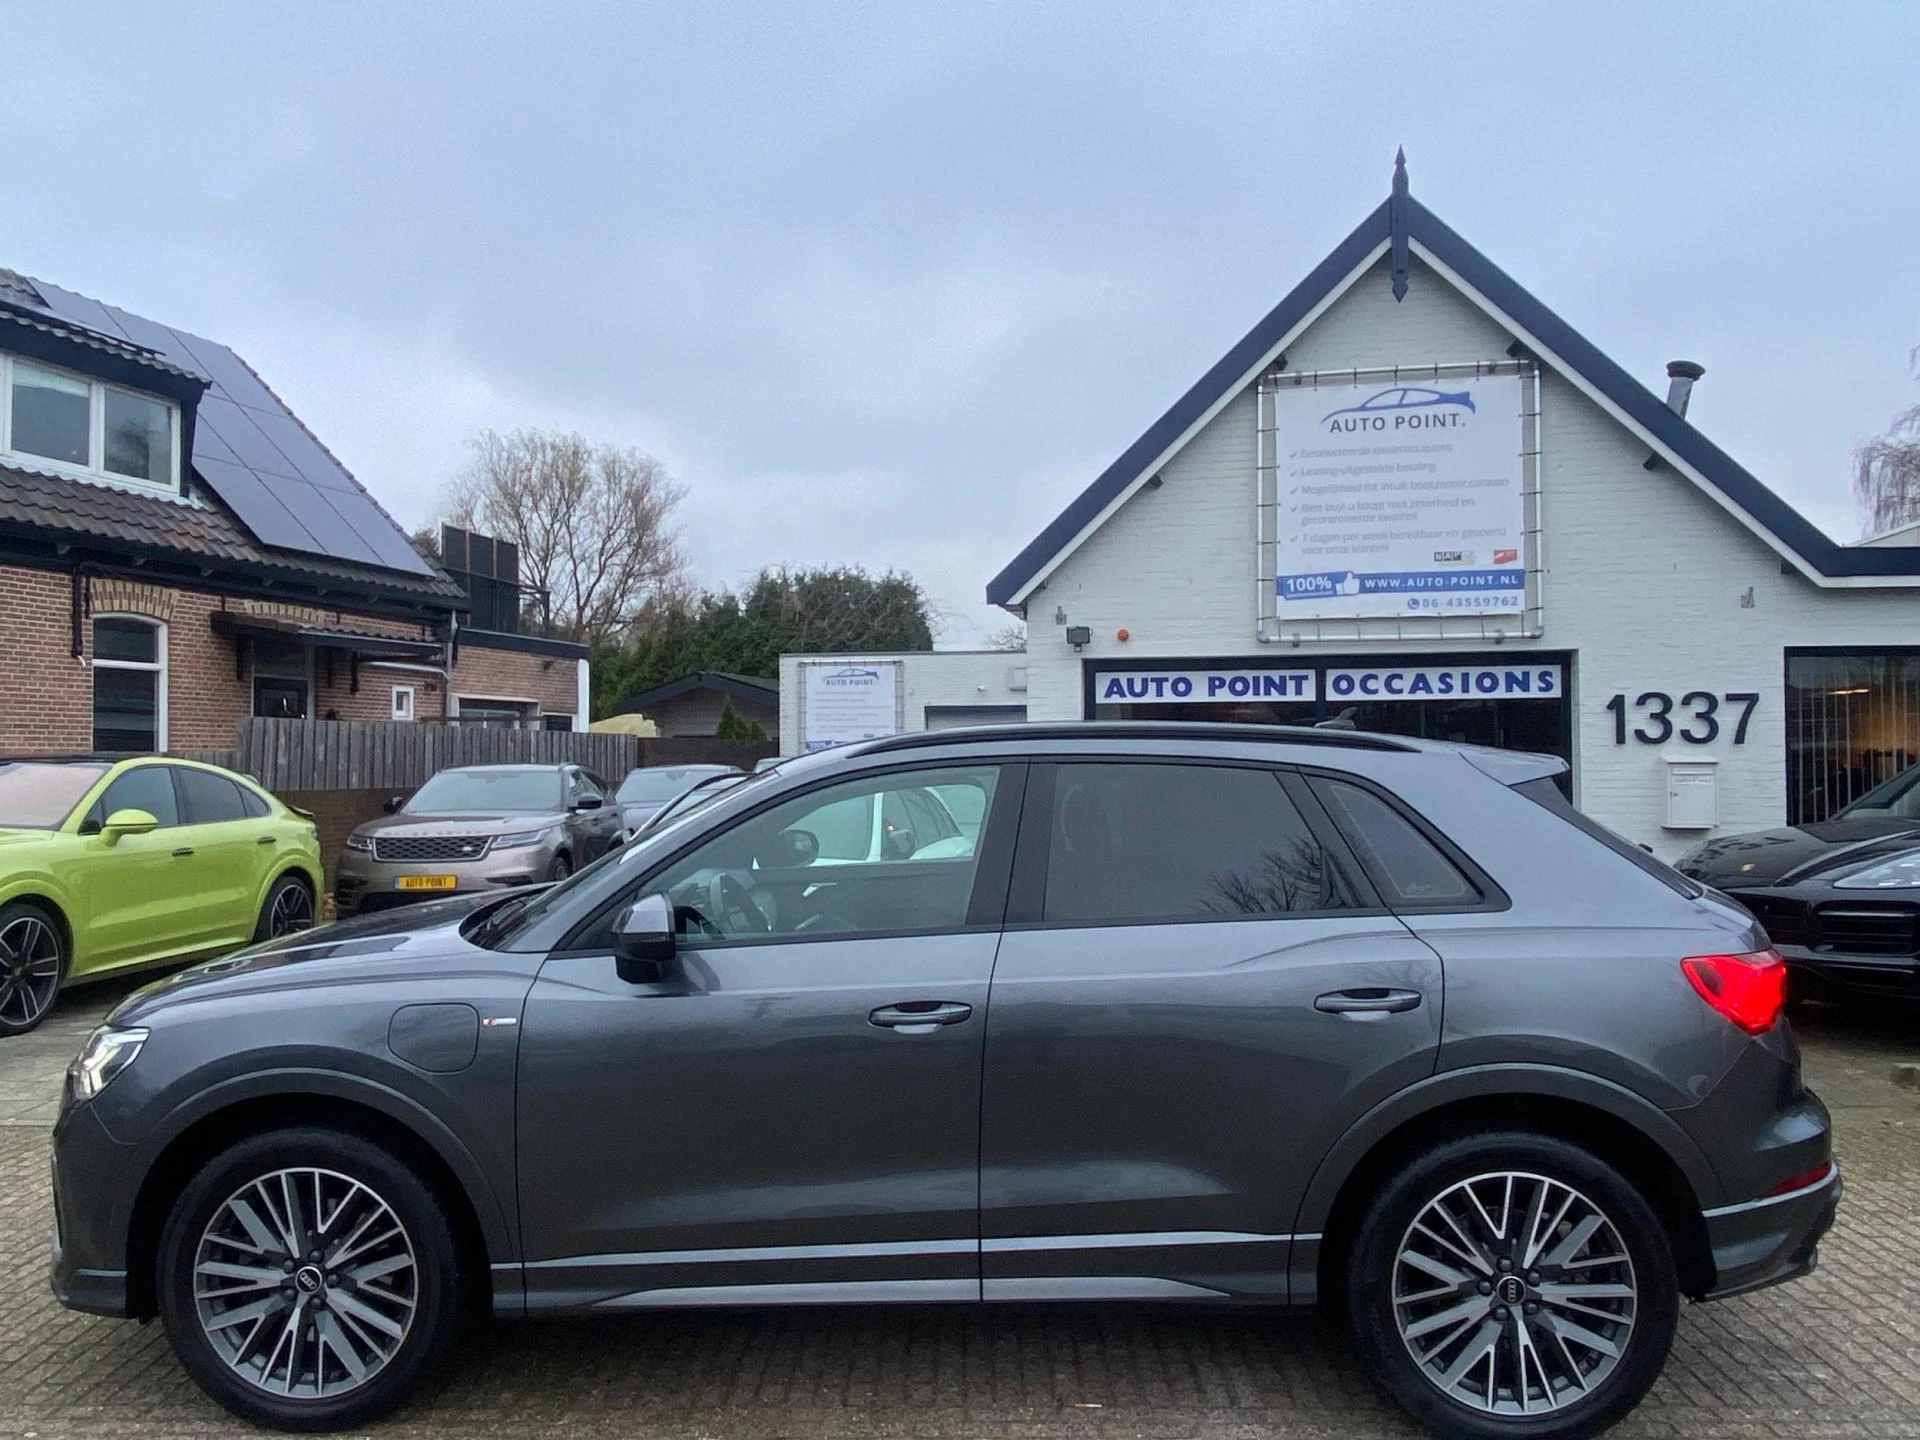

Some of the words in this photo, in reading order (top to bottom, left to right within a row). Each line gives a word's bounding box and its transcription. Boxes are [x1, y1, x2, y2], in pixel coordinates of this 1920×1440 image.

[1330, 417, 1386, 433] AUTO
[1364, 482, 1378, 492] tot
[1302, 503, 1322, 513] Best
[1357, 501, 1385, 513] koopt
[1310, 533, 1340, 545] dagen
[1343, 533, 1359, 544] per
[1445, 529, 1458, 538] en
[1302, 546, 1323, 555] voor
[1325, 546, 1350, 554] onze
[1287, 576, 1332, 592] 100%
[1104, 677, 1193, 698] AUTO
[1208, 675, 1309, 697] POINT
[1332, 671, 1555, 695] OCCASIONS
[1606, 691, 1760, 745] 1337
